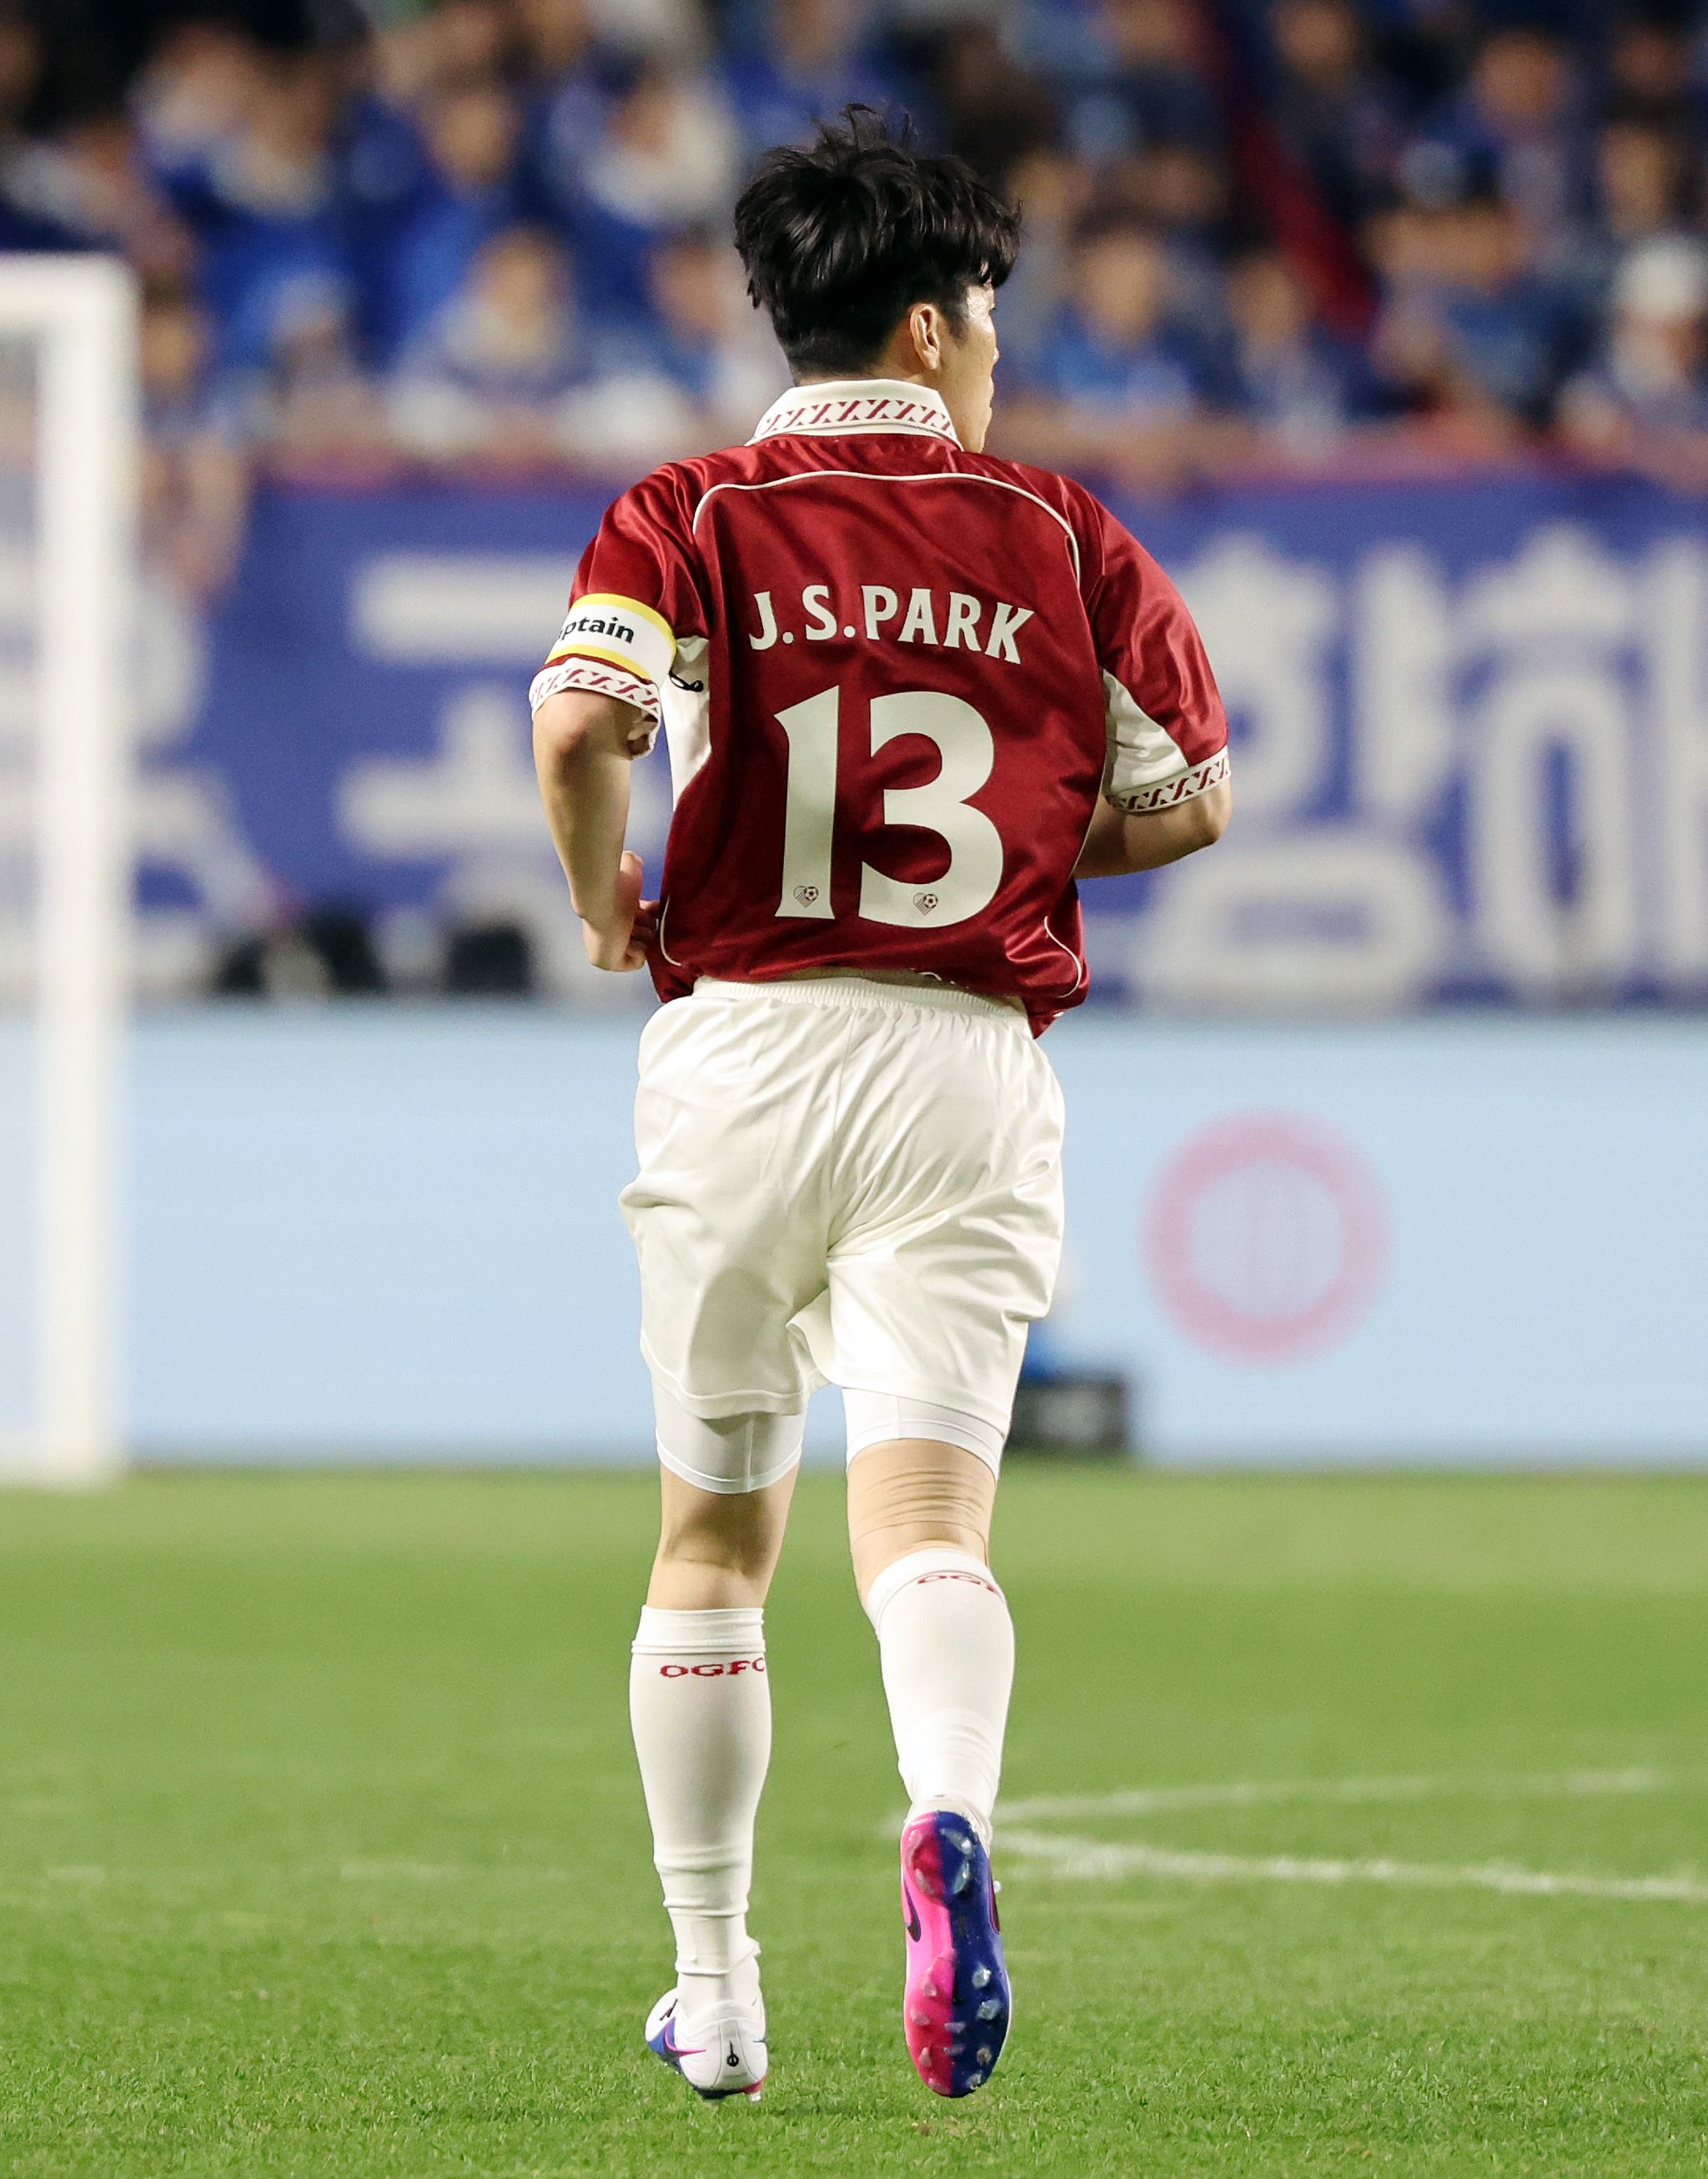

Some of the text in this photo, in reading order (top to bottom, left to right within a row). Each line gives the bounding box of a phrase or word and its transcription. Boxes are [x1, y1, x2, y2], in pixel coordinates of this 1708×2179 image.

[558, 616, 635, 644] ptain
[749, 585, 1035, 665] J.S.PARK
[774, 685, 1004, 928] 13
